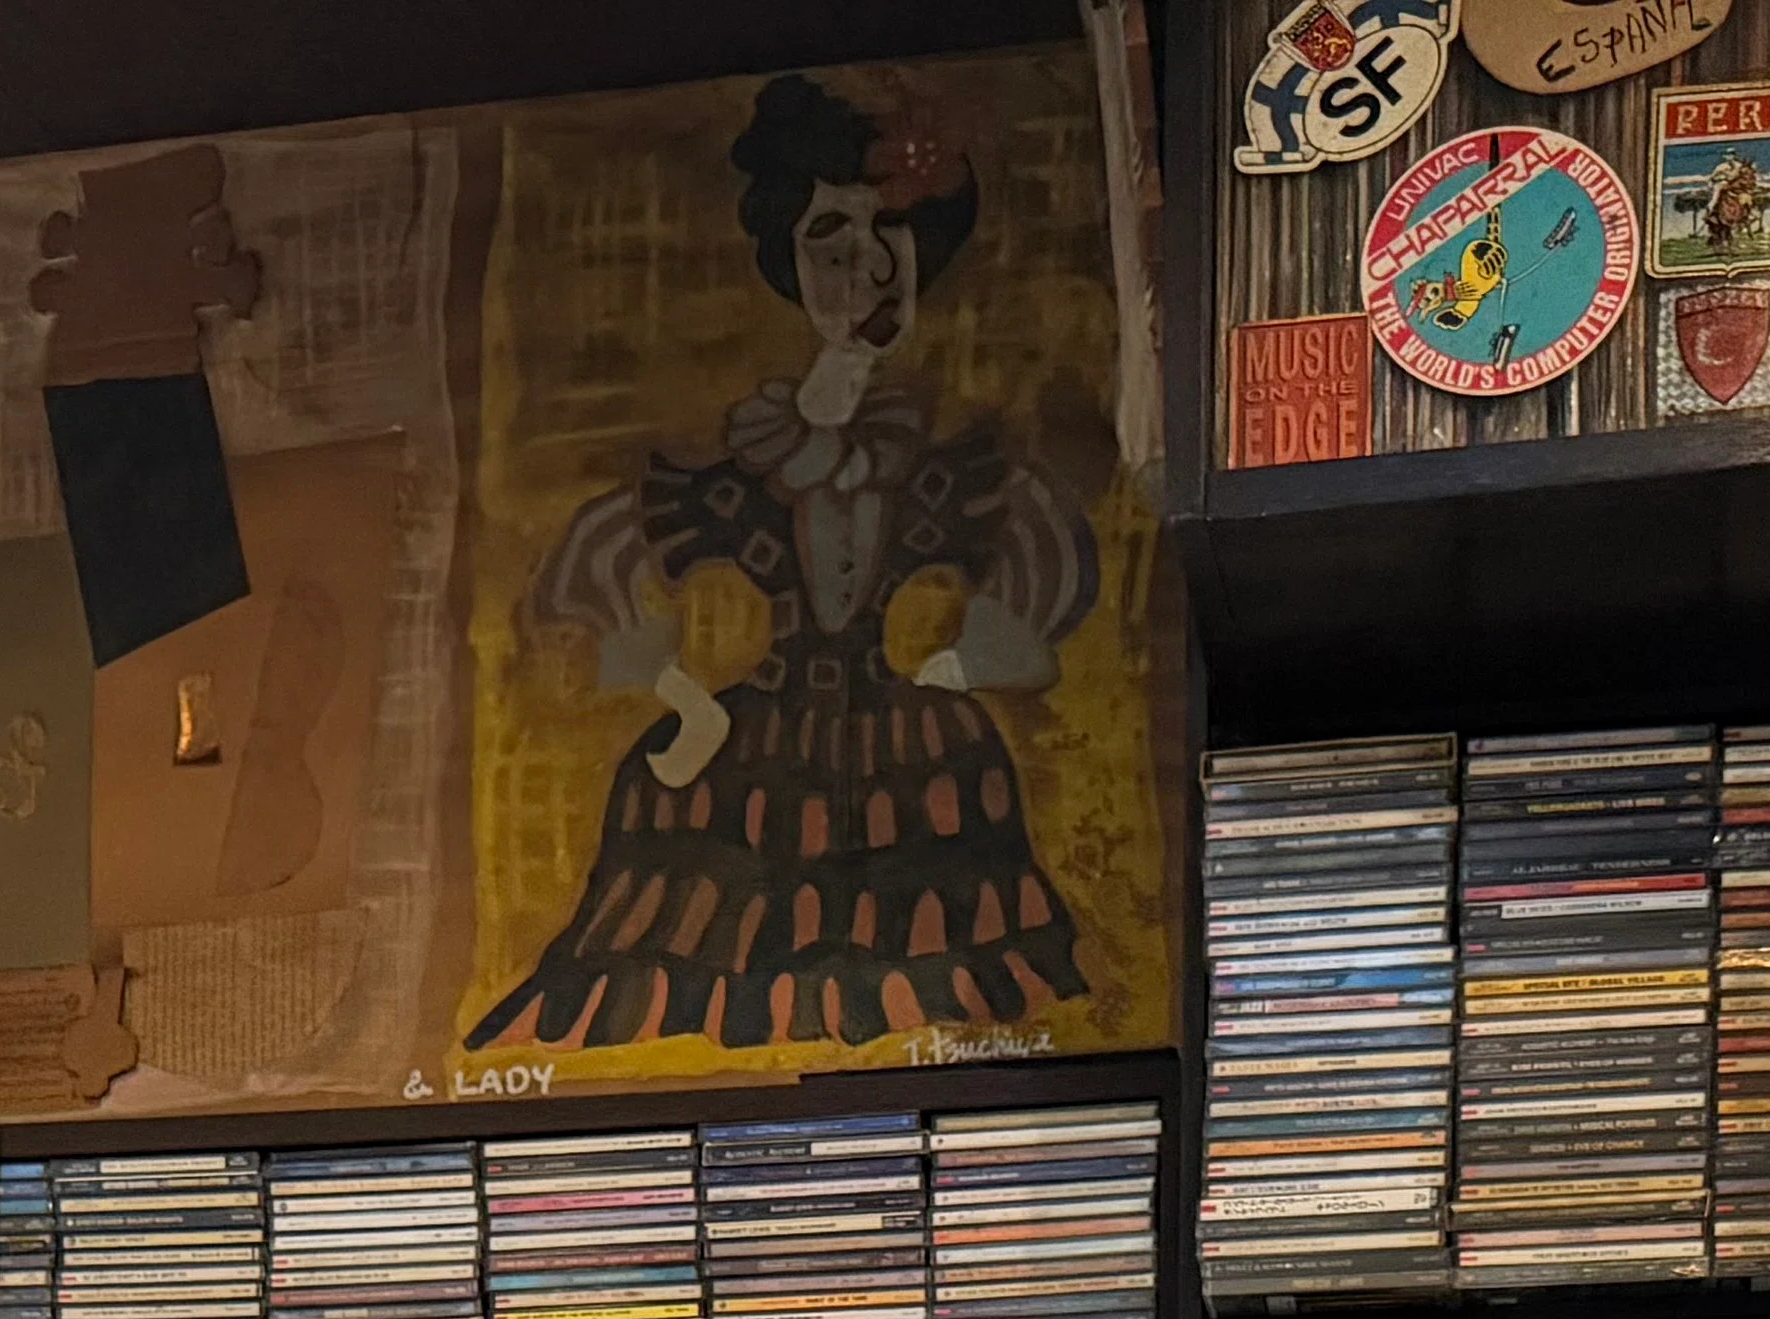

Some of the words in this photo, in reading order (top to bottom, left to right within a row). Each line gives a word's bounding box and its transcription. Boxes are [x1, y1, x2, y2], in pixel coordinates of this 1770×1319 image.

[1317, 36, 1412, 139] SF
[1368, 138, 1569, 281] CHAPARRAL
[1386, 142, 1480, 222] UNIVAC
[1372, 292, 1406, 341] THE
[1399, 334, 1495, 388] WORLD'S
[1506, 291, 1619, 387] COMPUTER
[1567, 152, 1630, 281] ORIGINATOR
[1245, 324, 1359, 383] MUSIC
[1246, 384, 1289, 403] ON
[1294, 380, 1359, 397] THE
[1245, 398, 1358, 466] EDGE
[403, 1070, 433, 1098] &
[454, 1062, 554, 1096] LADY
